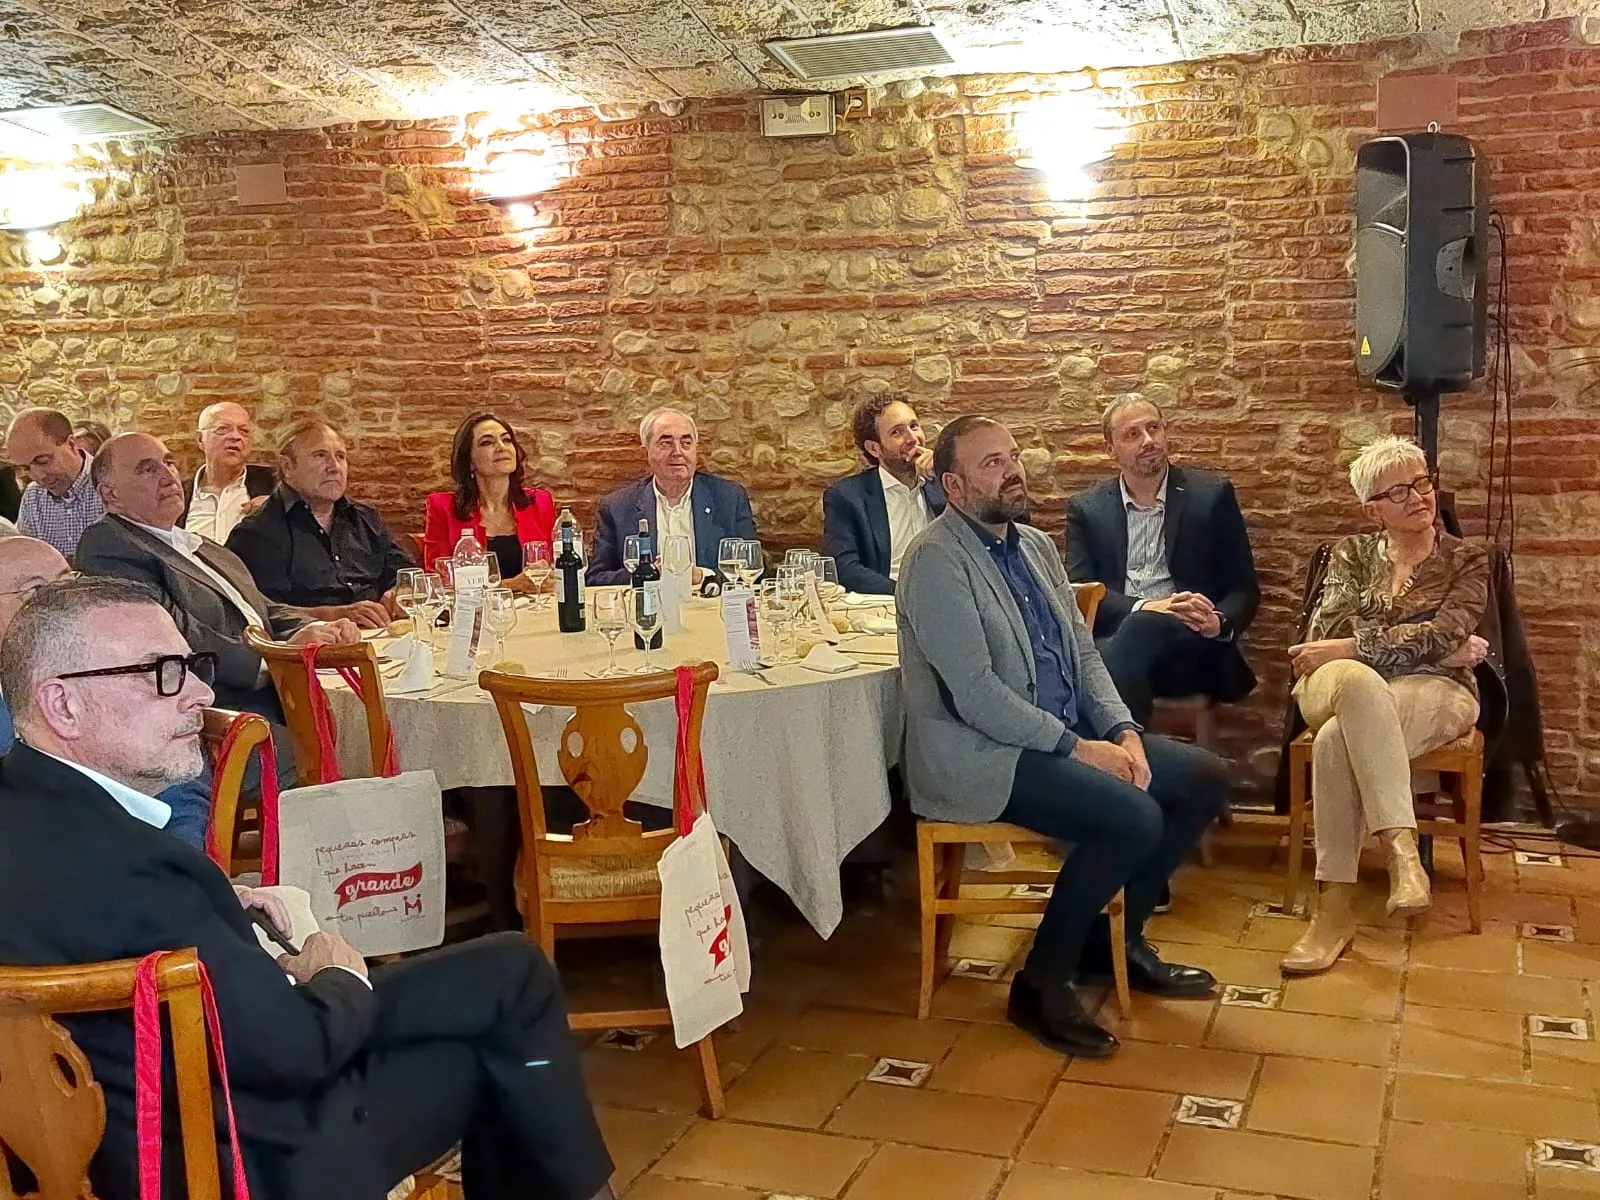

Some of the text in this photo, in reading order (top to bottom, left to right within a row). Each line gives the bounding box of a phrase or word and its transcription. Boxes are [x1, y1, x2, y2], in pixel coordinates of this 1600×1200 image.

[371, 831, 417, 856] compras
[324, 862, 376, 883] que hacen
[344, 874, 415, 901] grande
[696, 925, 712, 944] que
